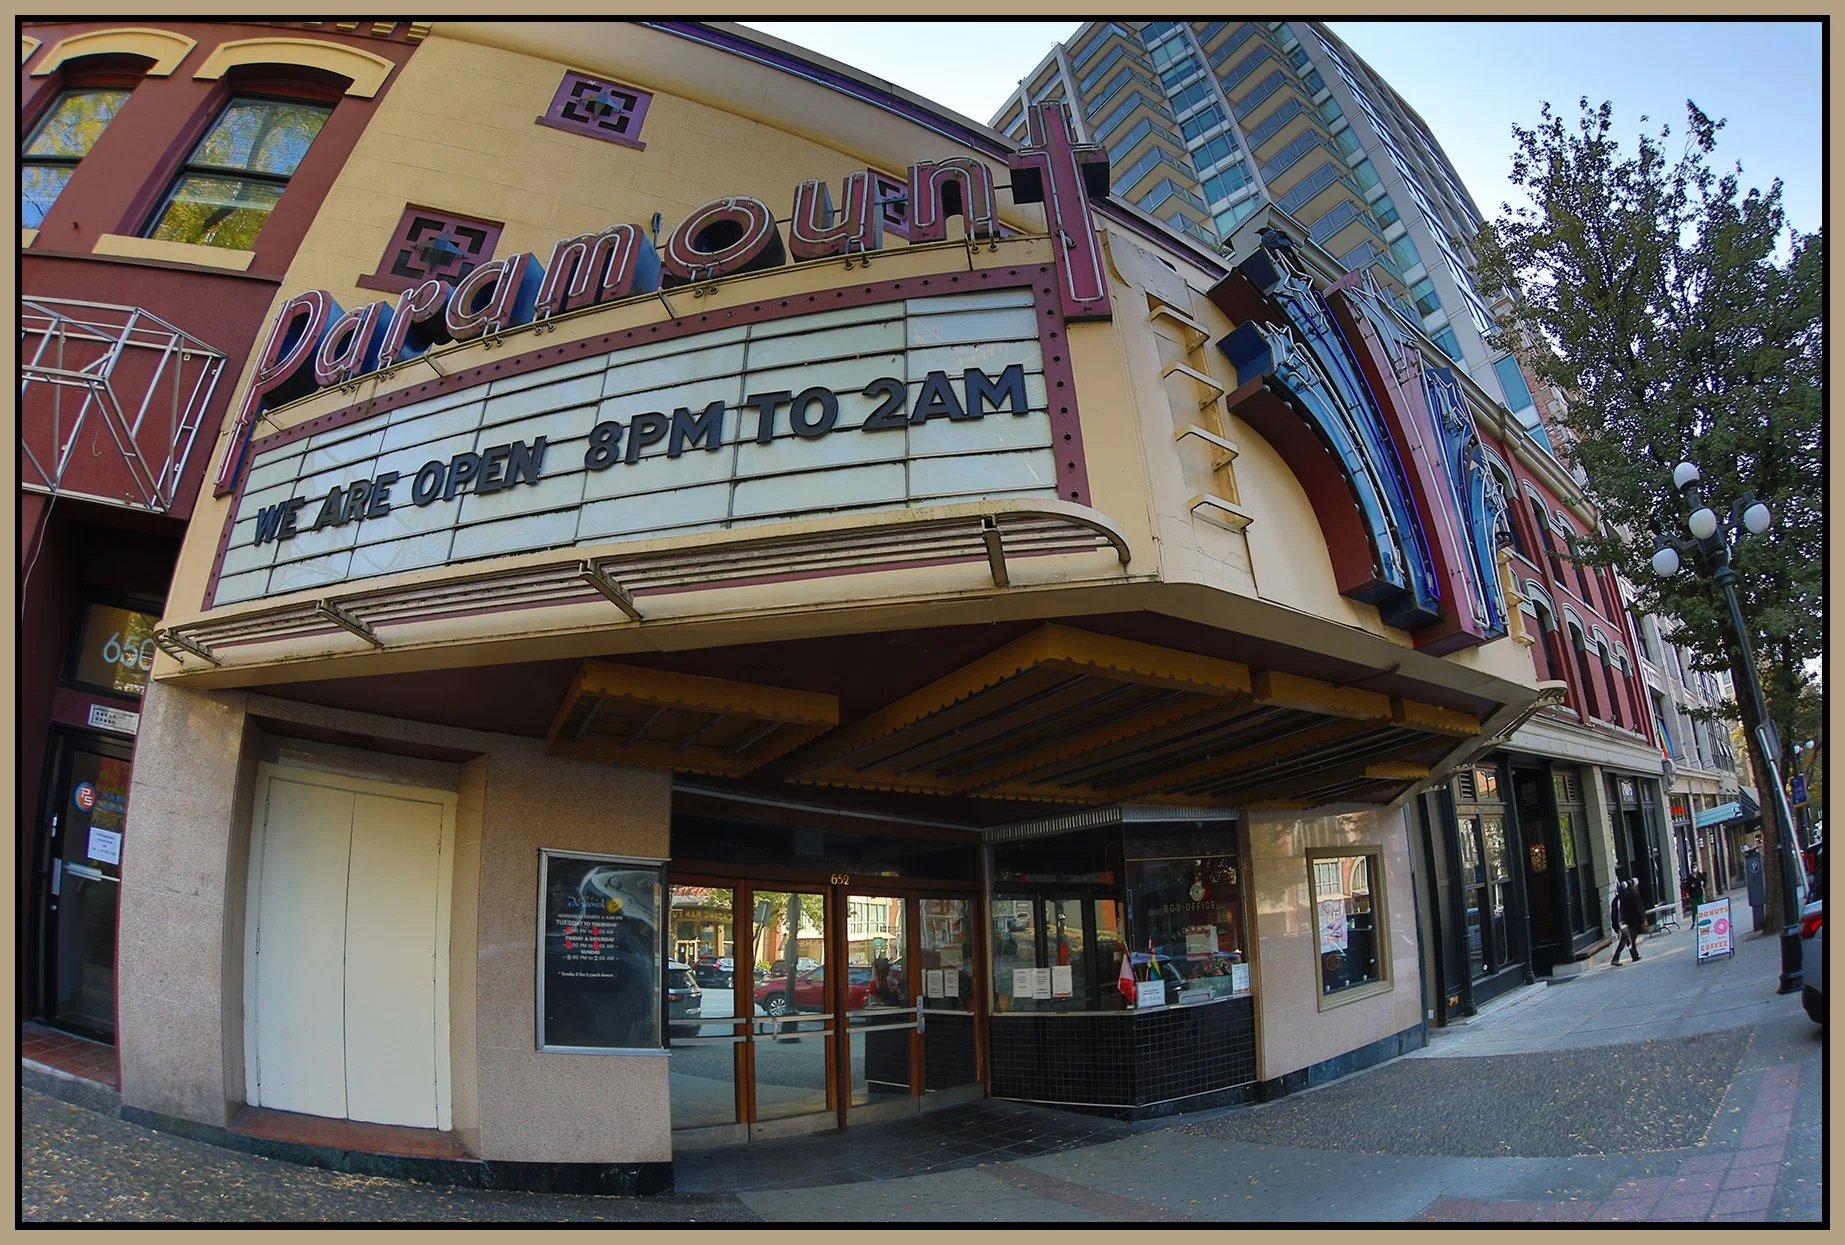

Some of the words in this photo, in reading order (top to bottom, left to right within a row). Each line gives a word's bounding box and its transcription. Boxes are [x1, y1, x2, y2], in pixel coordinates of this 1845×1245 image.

[254, 496, 305, 547] WE
[313, 471, 400, 534] ARE
[411, 435, 548, 507] OPEN
[583, 400, 725, 473] 8PM
[747, 386, 839, 445] TO
[861, 363, 1030, 432] 2AM
[103, 631, 154, 671] 650
[831, 873, 850, 886] 652
[1163, 903, 1181, 913] BOX
[1185, 901, 1216, 912] OFFICE
[1698, 906, 1729, 918] DONUTS
[1700, 940, 1728, 951] COFFEE
